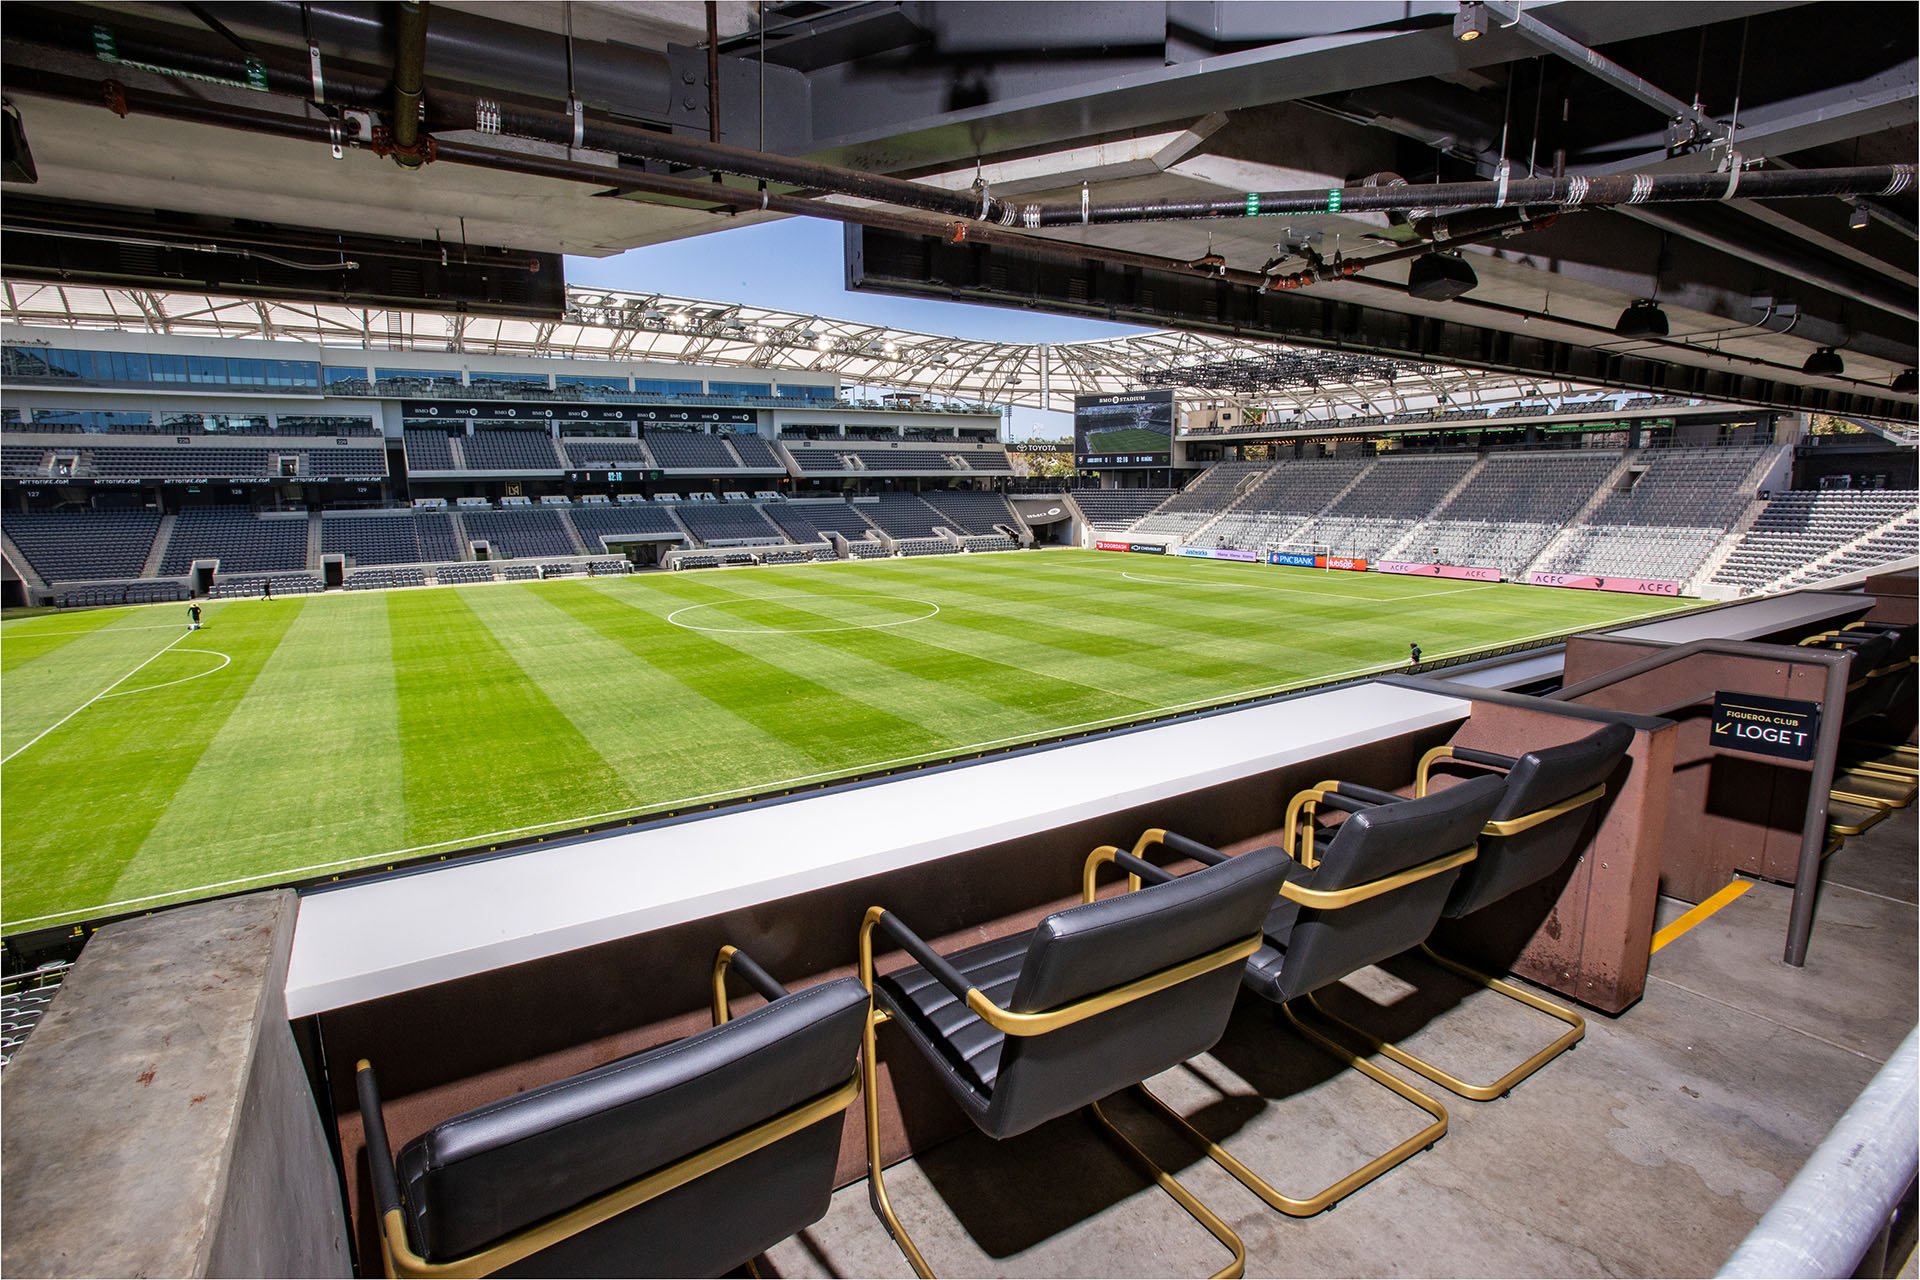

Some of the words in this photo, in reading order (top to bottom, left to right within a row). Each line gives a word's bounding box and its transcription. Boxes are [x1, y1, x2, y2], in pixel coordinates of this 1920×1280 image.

[1103, 542, 1127, 550] DOORDASH
[1280, 555, 1295, 564] PNC
[1295, 556, 1313, 565] BANK
[1535, 575, 1564, 585] ACFC
[1638, 583, 1672, 593] ACFC
[1726, 710, 1771, 723] FIGUEROA
[1773, 717, 1799, 727] CLUB
[1736, 723, 1808, 747] LOGET
